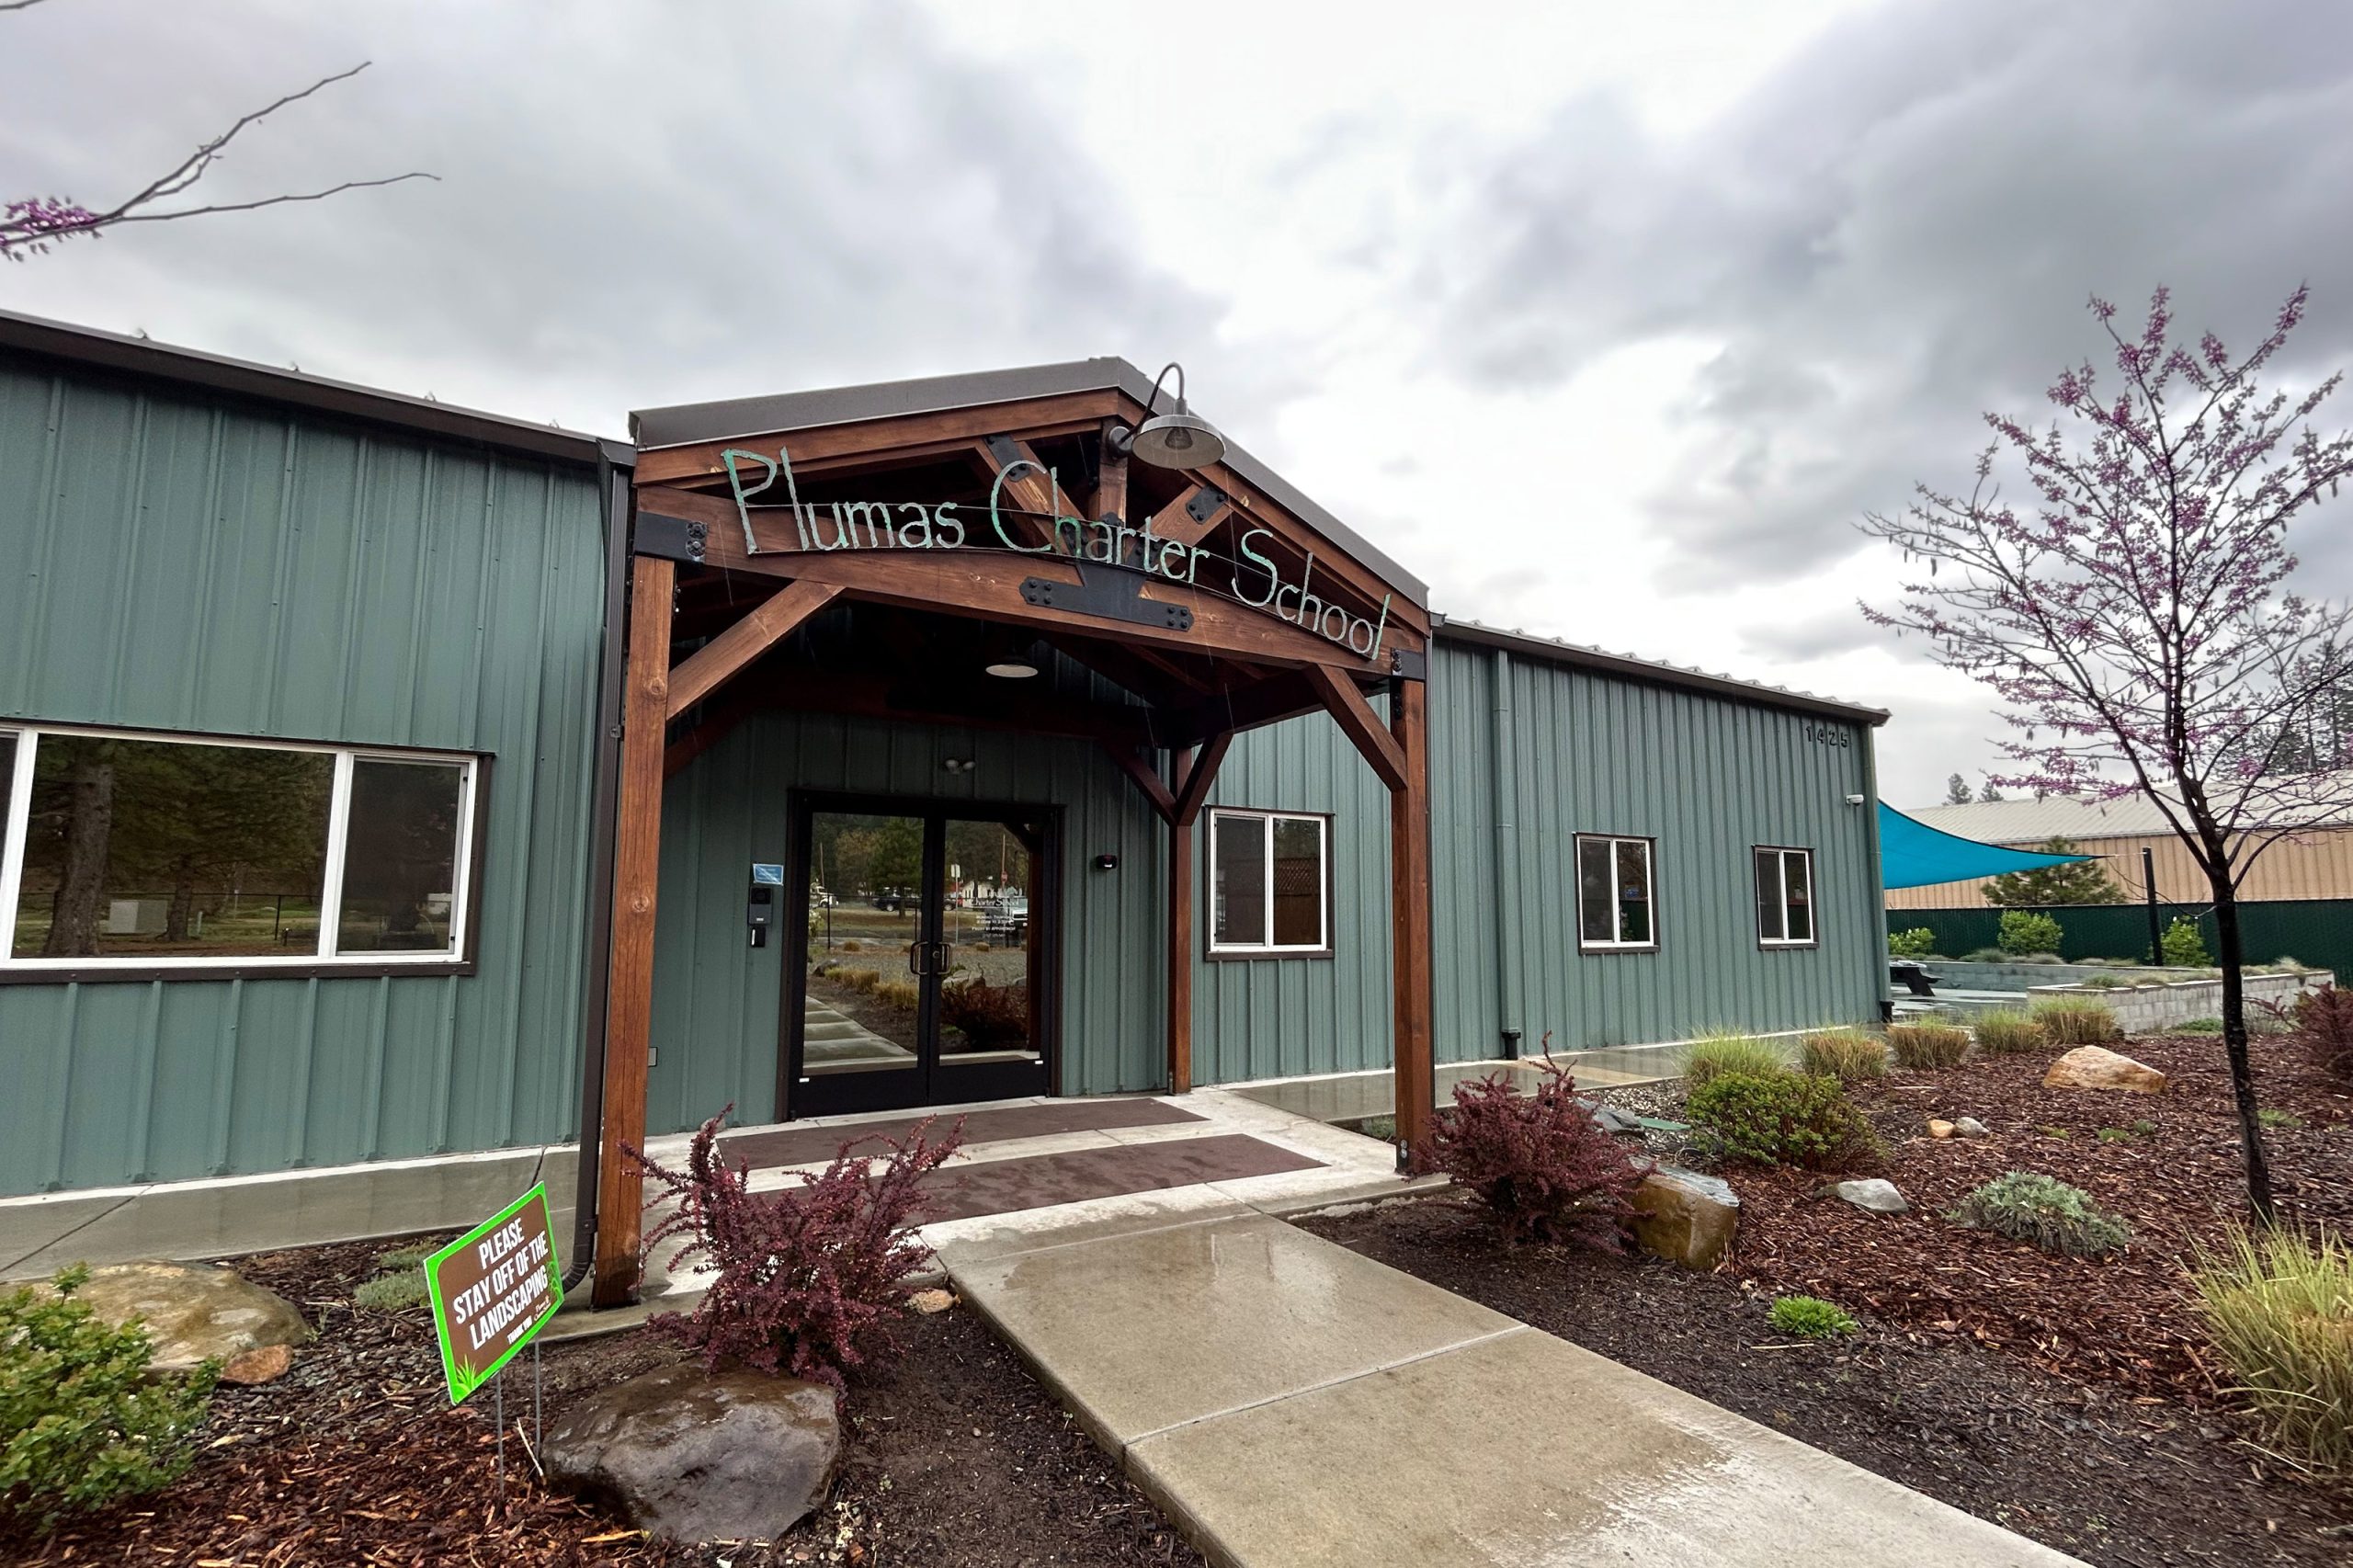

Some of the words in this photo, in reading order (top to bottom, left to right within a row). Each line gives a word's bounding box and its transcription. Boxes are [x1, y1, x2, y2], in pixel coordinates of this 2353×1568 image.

[721, 446, 965, 555] Plumas
[990, 460, 1210, 584] Charter
[1232, 528, 1392, 660] School
[1806, 726, 1848, 747] 1425
[453, 1276, 491, 1324] STAY
[492, 1257, 515, 1296] OFF
[515, 1245, 529, 1277] OF
[529, 1230, 549, 1265] THE
[478, 1218, 525, 1270] PLEASE
[470, 1265, 549, 1350] LANDSCAPING
